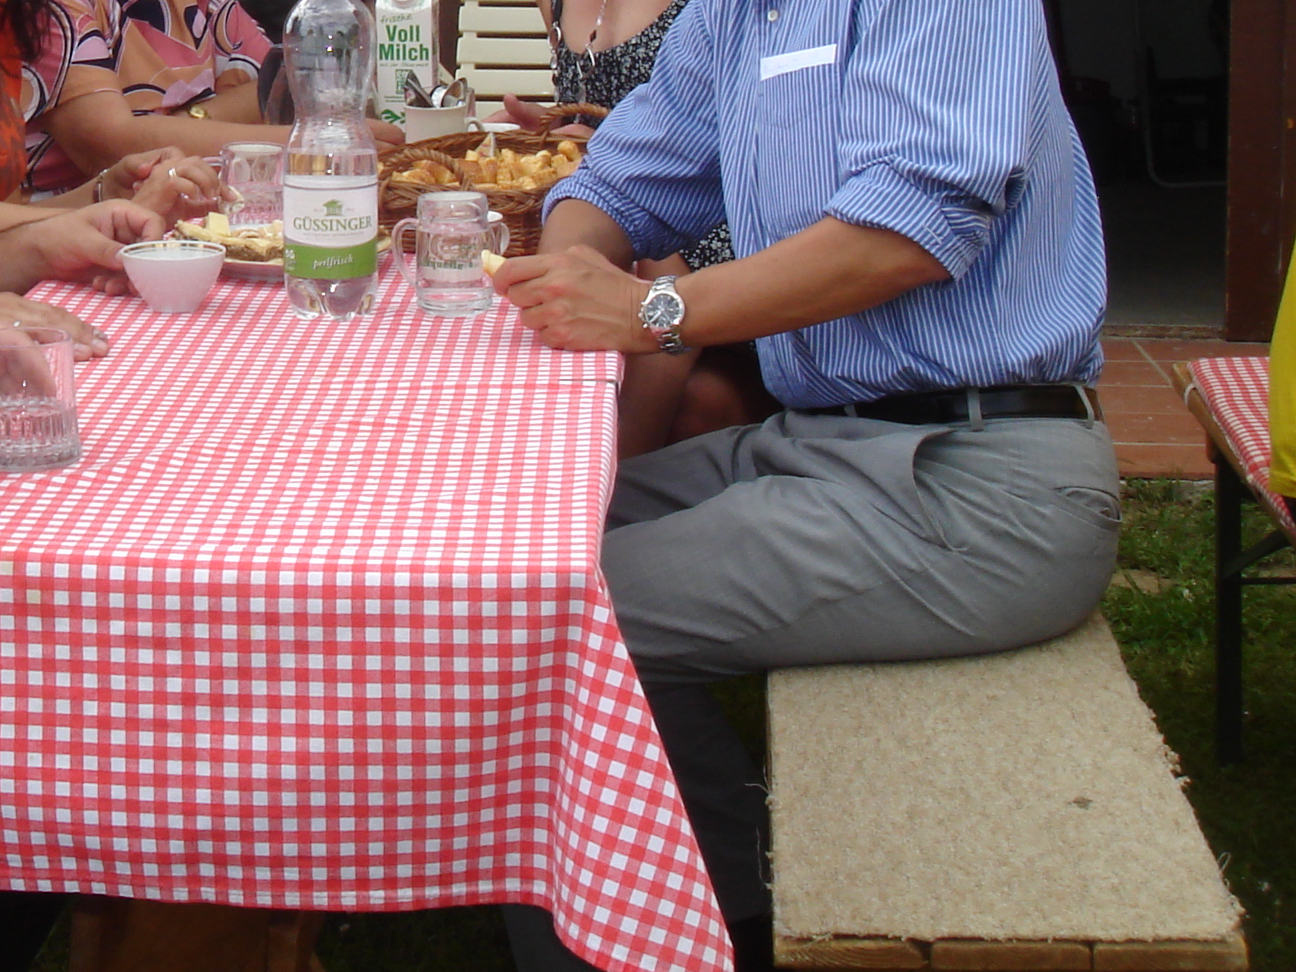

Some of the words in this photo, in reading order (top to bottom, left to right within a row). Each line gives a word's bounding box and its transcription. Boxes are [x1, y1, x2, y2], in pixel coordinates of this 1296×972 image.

[385, 24, 420, 42] Voll
[379, 43, 429, 61] Milch
[293, 215, 372, 232] GÜSSINGER
